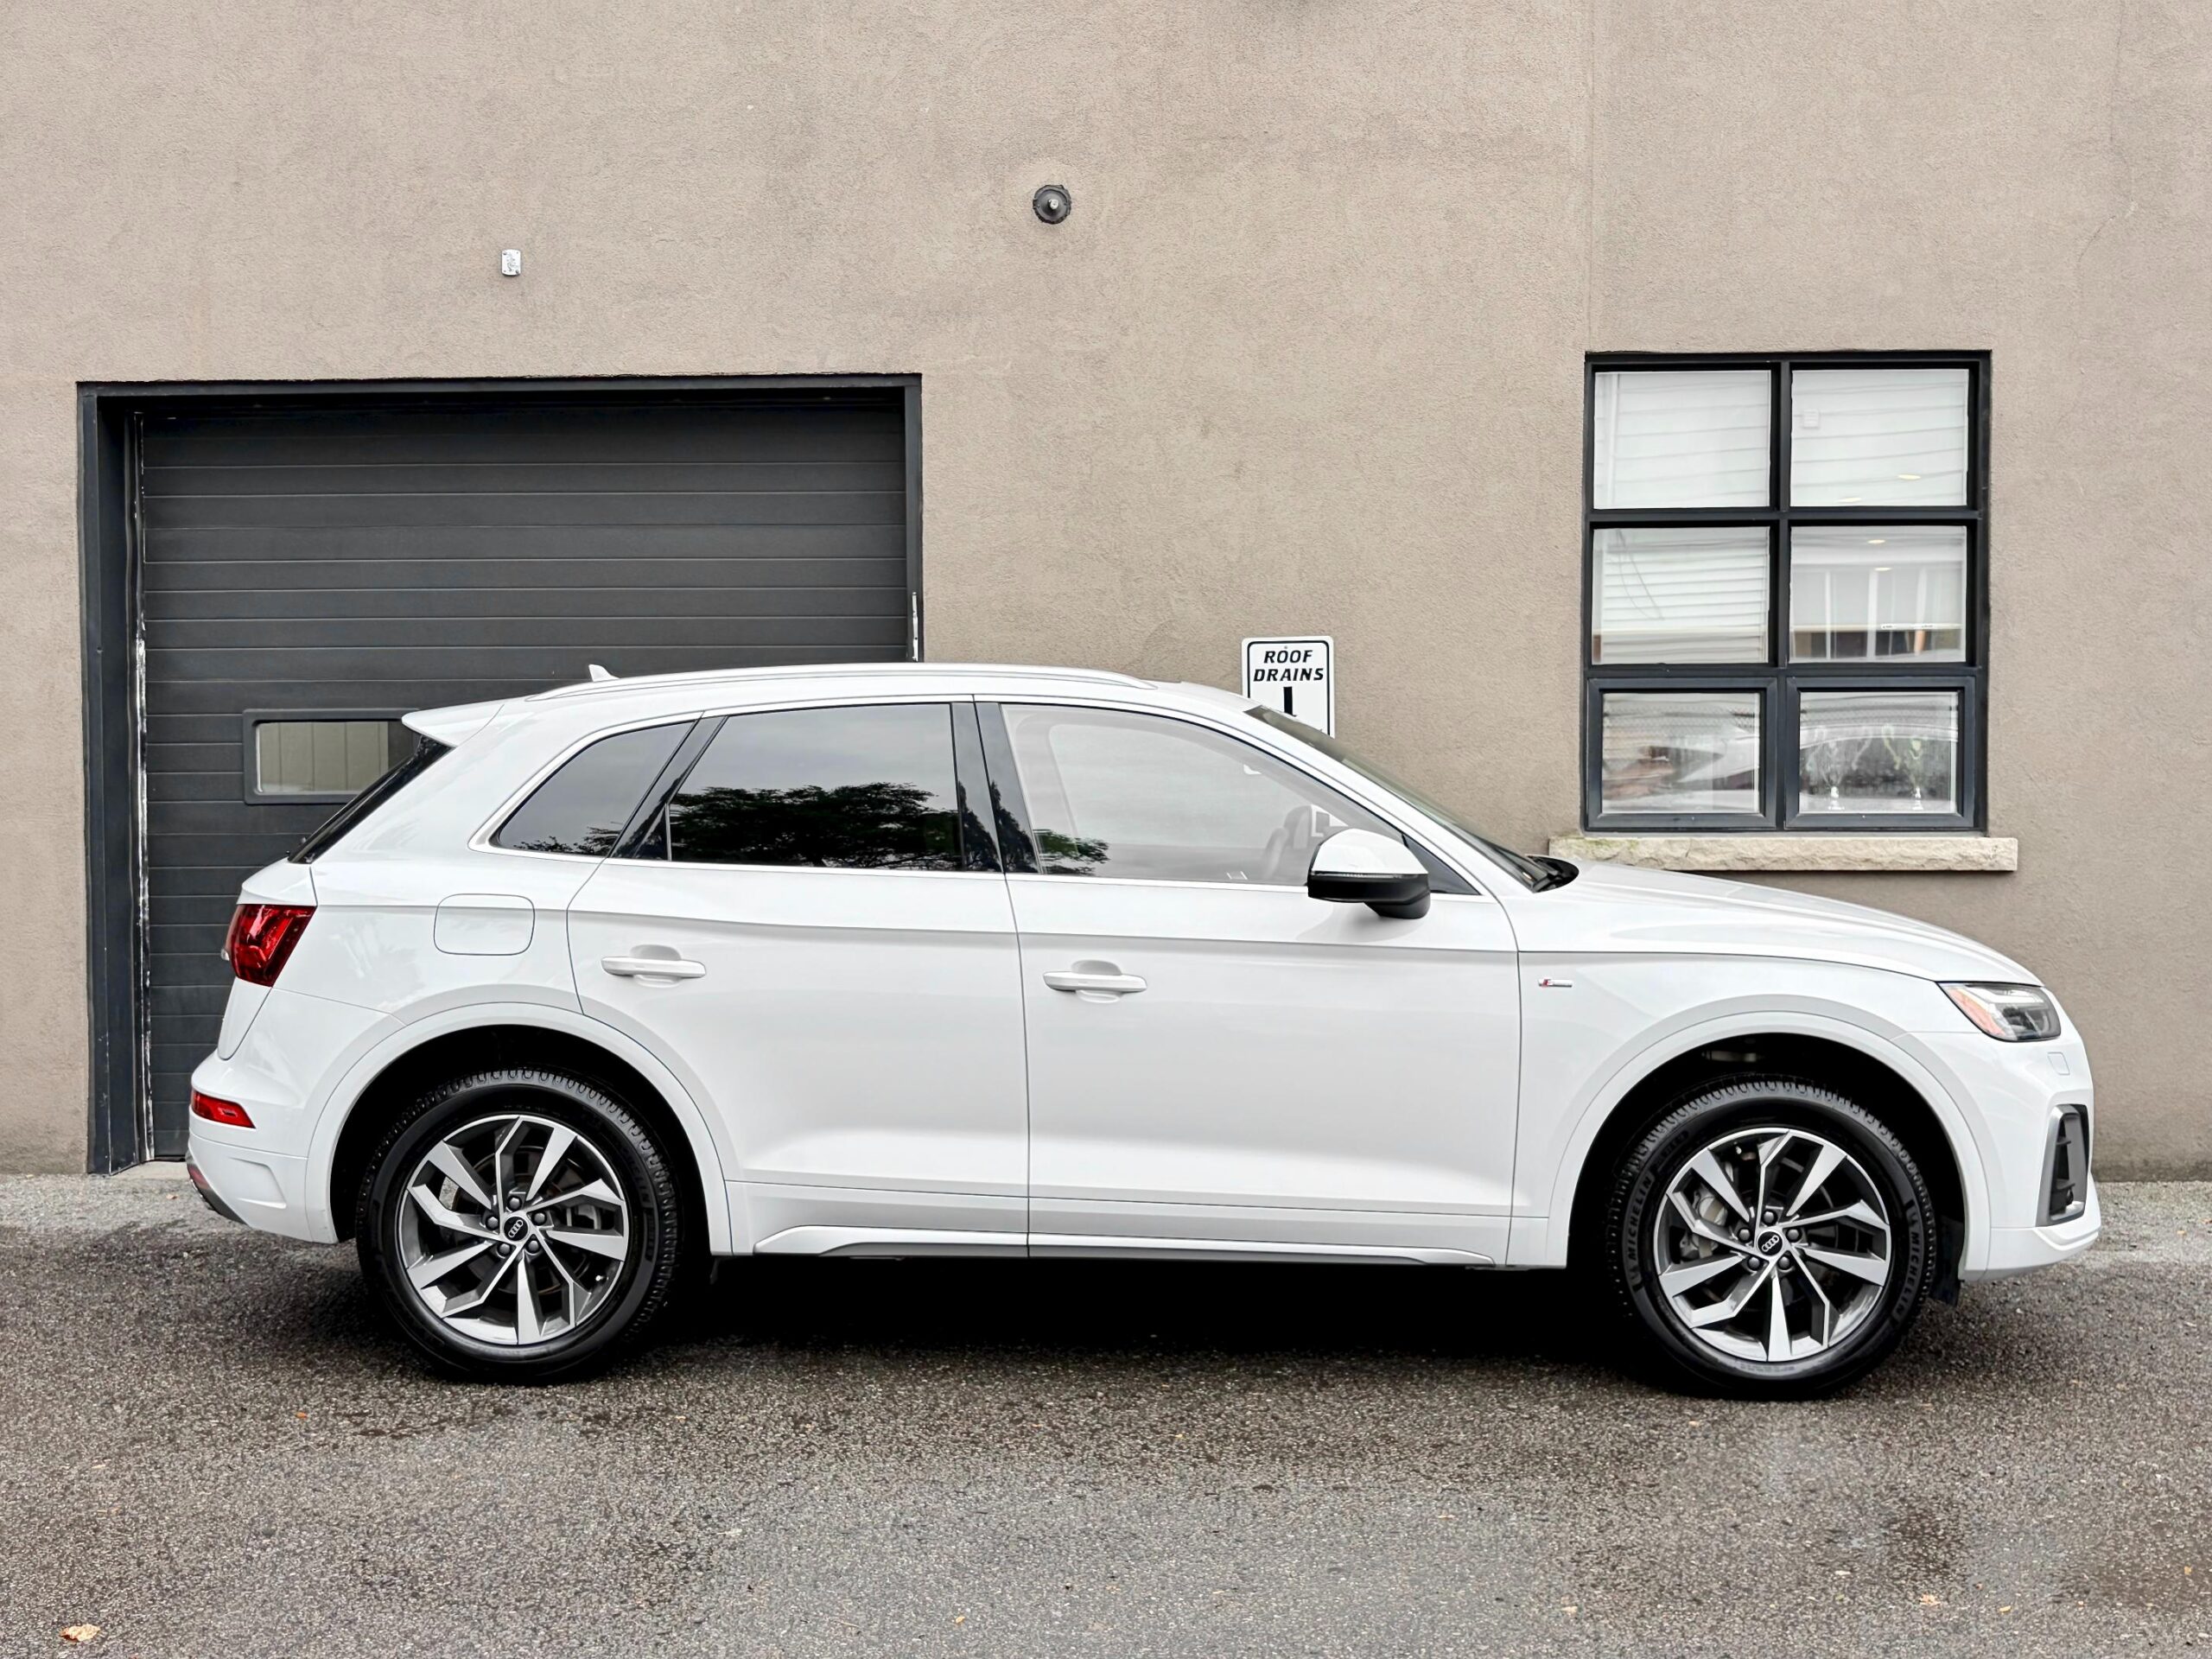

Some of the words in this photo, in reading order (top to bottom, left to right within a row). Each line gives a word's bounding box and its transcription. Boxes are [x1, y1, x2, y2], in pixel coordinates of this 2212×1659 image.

[1253, 668, 1324, 682] DRAINS
[1263, 650, 1313, 664] ROOF
[1627, 1176, 1652, 1261] MICHELIN
[1896, 1231, 1920, 1315] MICHELIN
